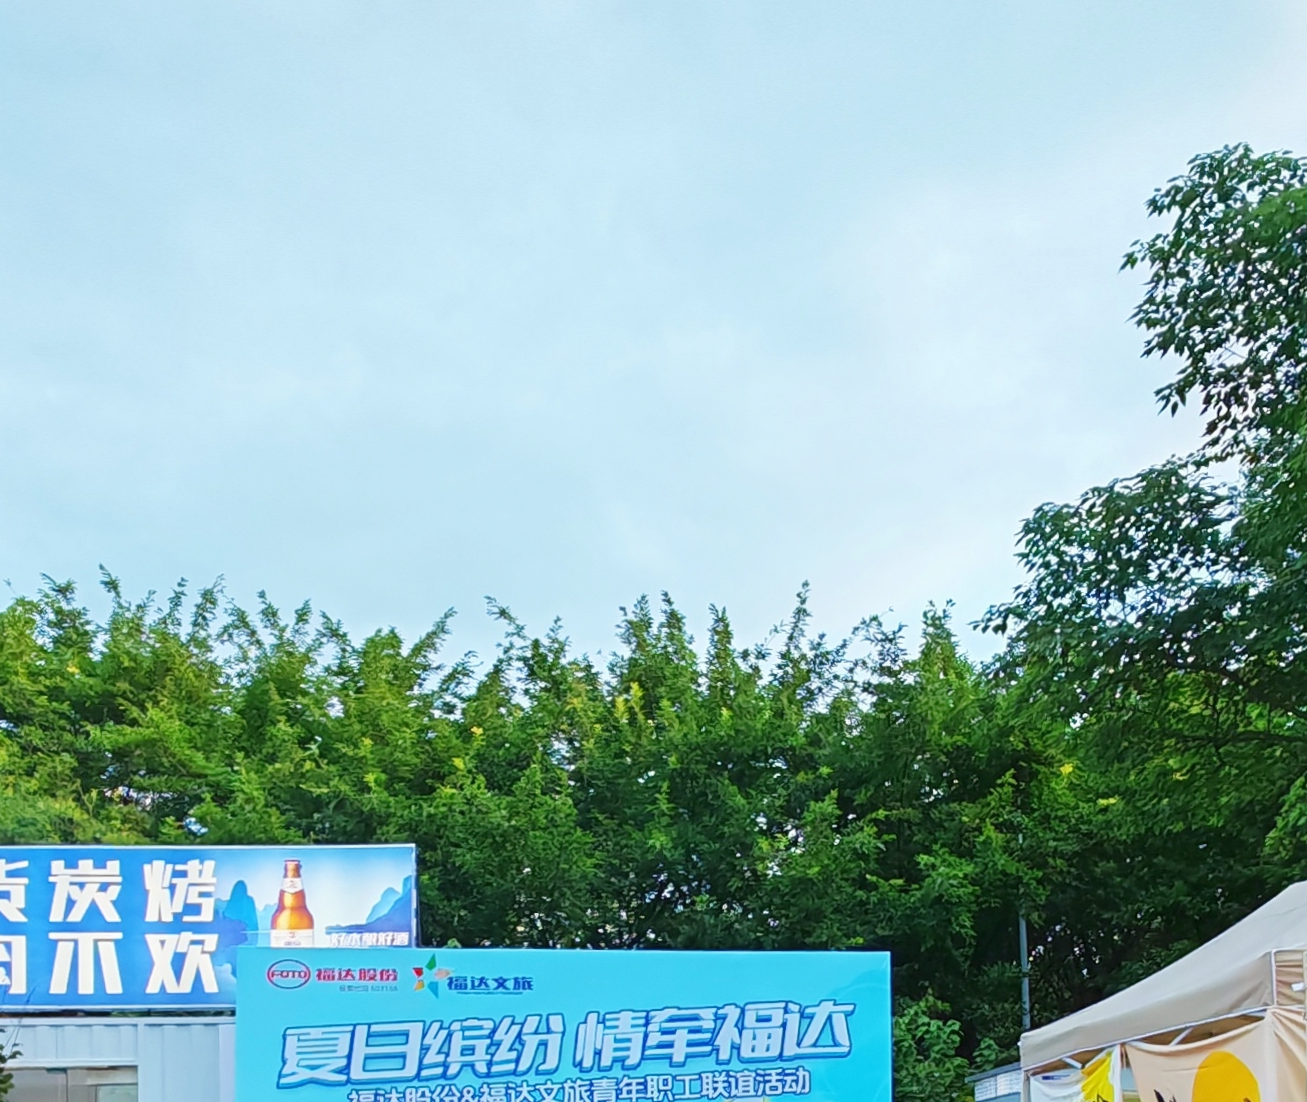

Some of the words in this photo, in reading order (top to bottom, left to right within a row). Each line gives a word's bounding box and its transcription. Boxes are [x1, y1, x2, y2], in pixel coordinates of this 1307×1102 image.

[315, 968, 398, 981] 福达股份
[447, 976, 534, 991] 福达文旅
[277, 1015, 566, 1090] 夏日缤纷
[572, 999, 857, 1072] 情牵福达
